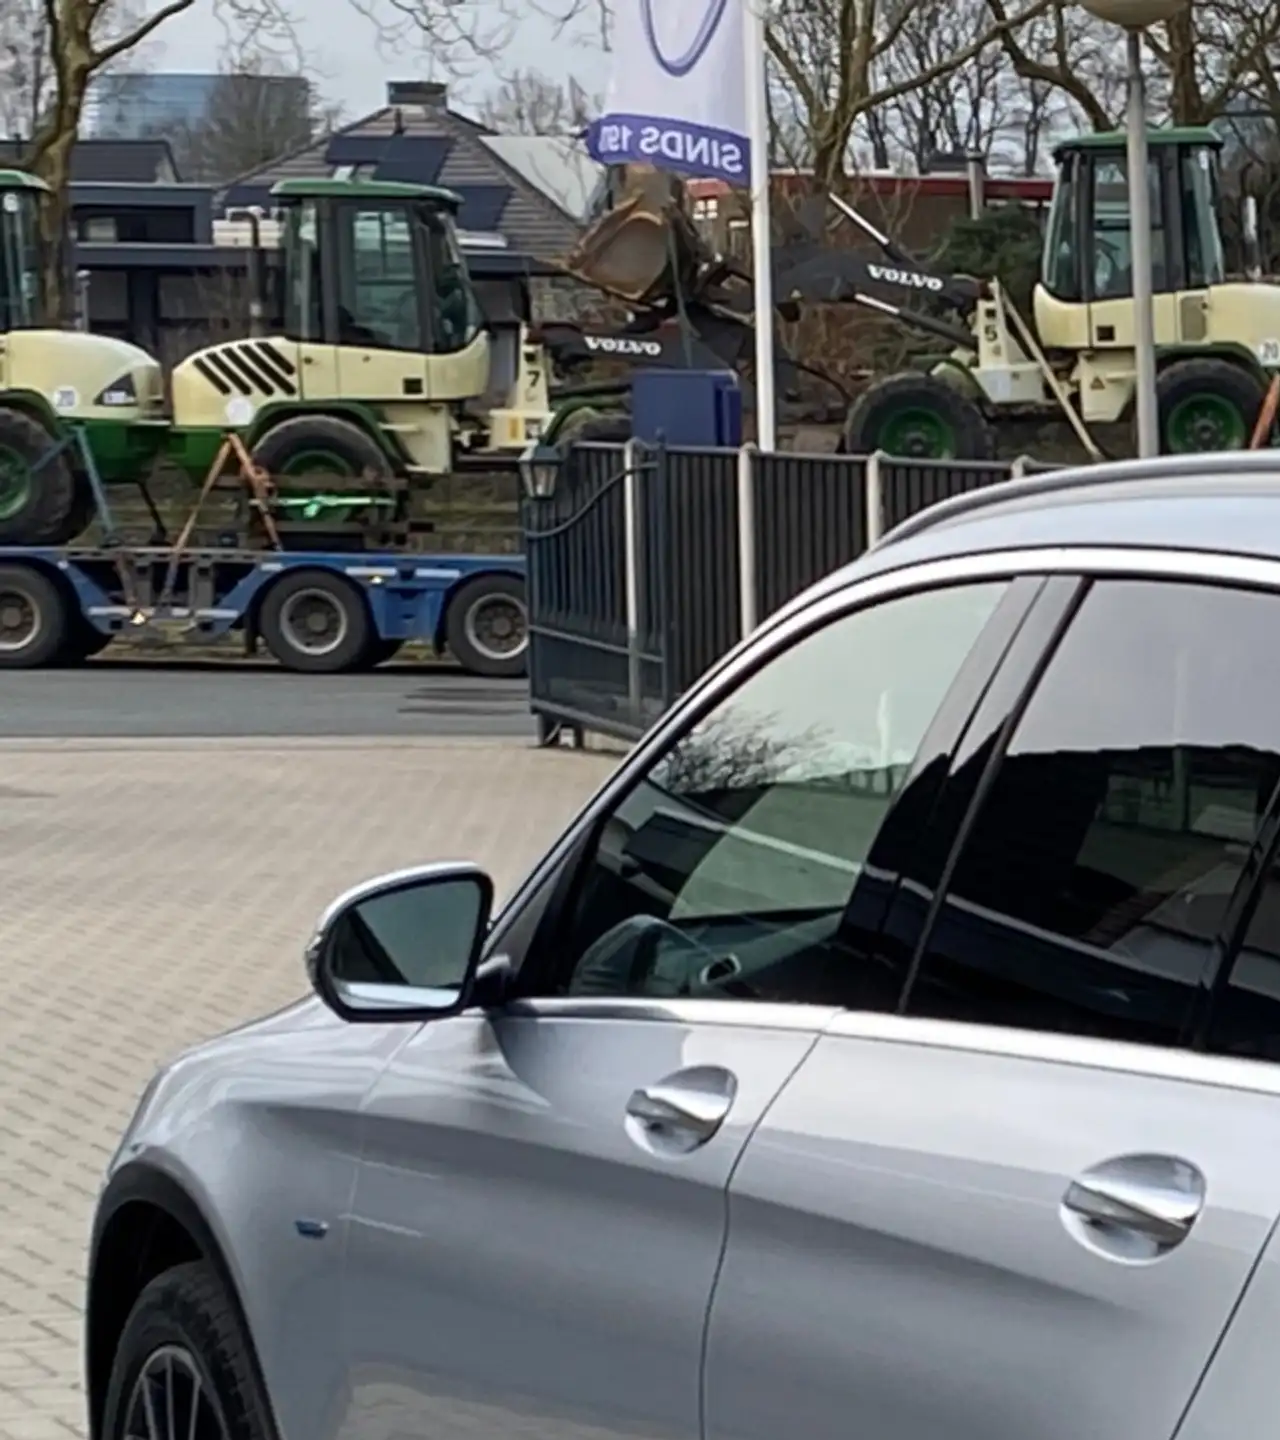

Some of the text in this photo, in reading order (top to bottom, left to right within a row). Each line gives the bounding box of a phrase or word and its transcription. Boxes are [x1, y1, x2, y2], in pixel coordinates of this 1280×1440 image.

[867, 264, 944, 291] VOLVO
[584, 336, 662, 355] VOLVO
[527, 371, 540, 387] 7
